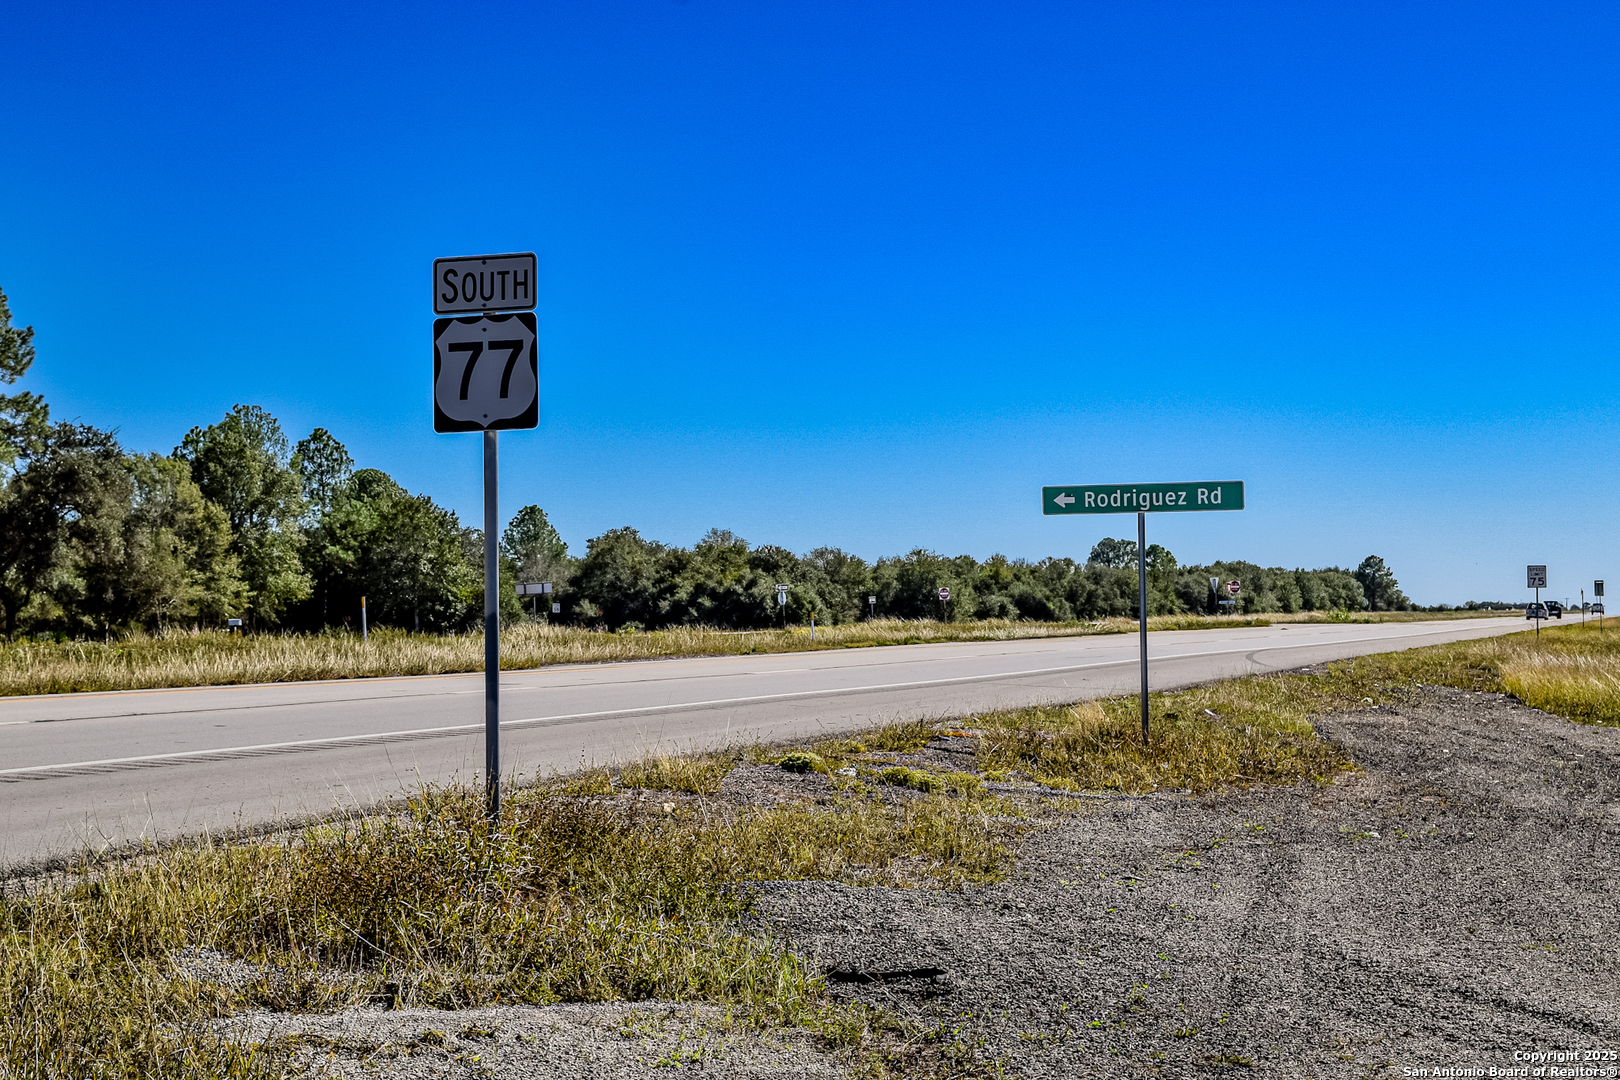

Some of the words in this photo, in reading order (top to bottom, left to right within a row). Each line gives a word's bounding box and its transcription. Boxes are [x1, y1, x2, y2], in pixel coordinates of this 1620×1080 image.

[441, 268, 529, 304] SOUTH
[448, 339, 524, 401] 77
[1084, 489, 1187, 511] Rodriguez
[1197, 486, 1222, 505] Rd
[1530, 577, 1545, 586] 75
